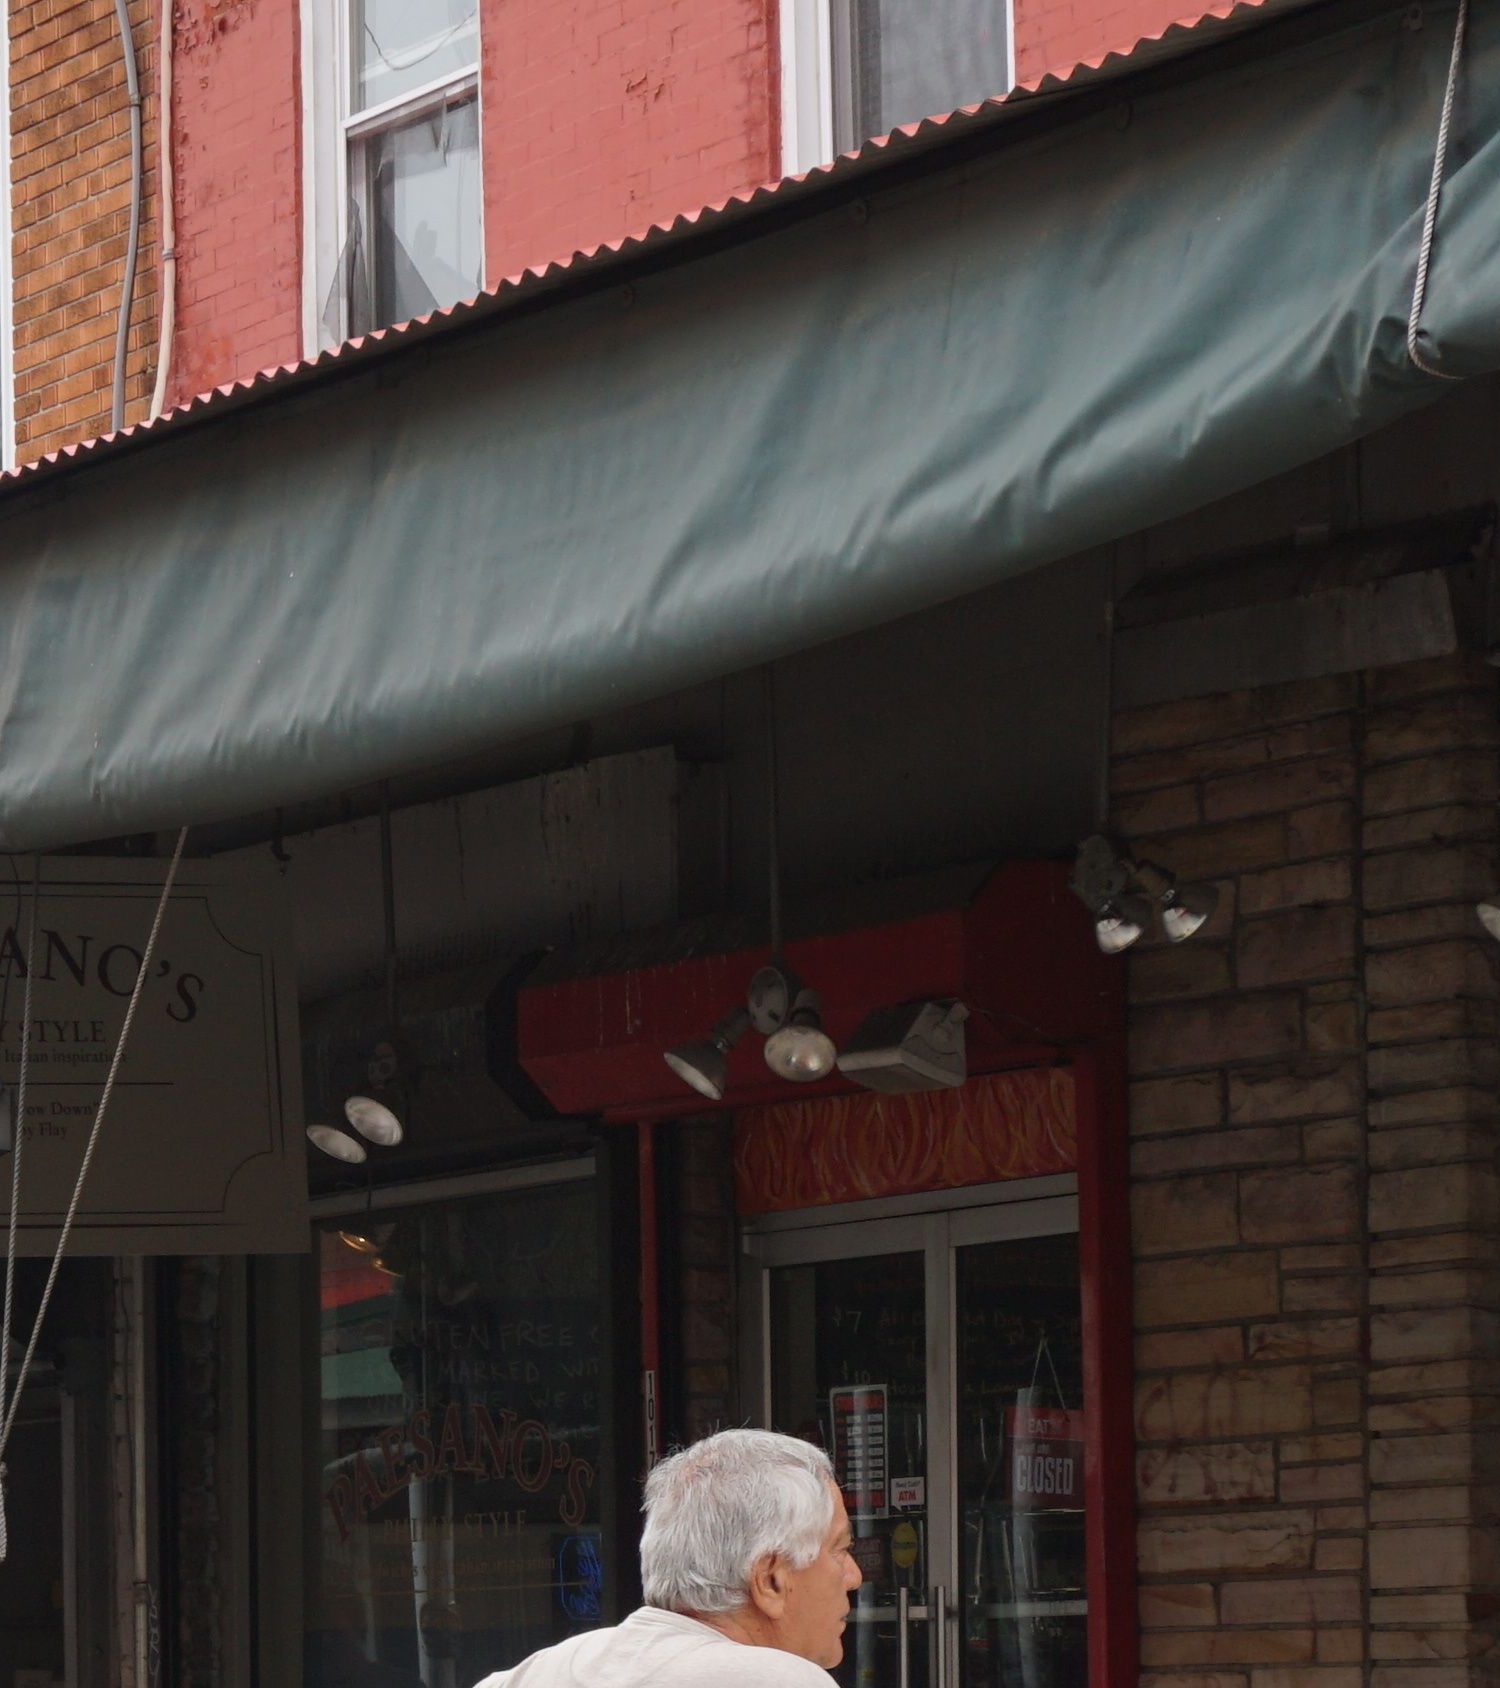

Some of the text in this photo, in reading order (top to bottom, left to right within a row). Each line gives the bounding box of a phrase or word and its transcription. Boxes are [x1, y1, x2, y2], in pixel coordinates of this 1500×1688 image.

[21, 1021, 106, 1042] STYLE
[323, 1401, 597, 1544] PAESANO'S
[1017, 1458, 1074, 1496] CLOSED
[898, 1490, 917, 1502] ATM
